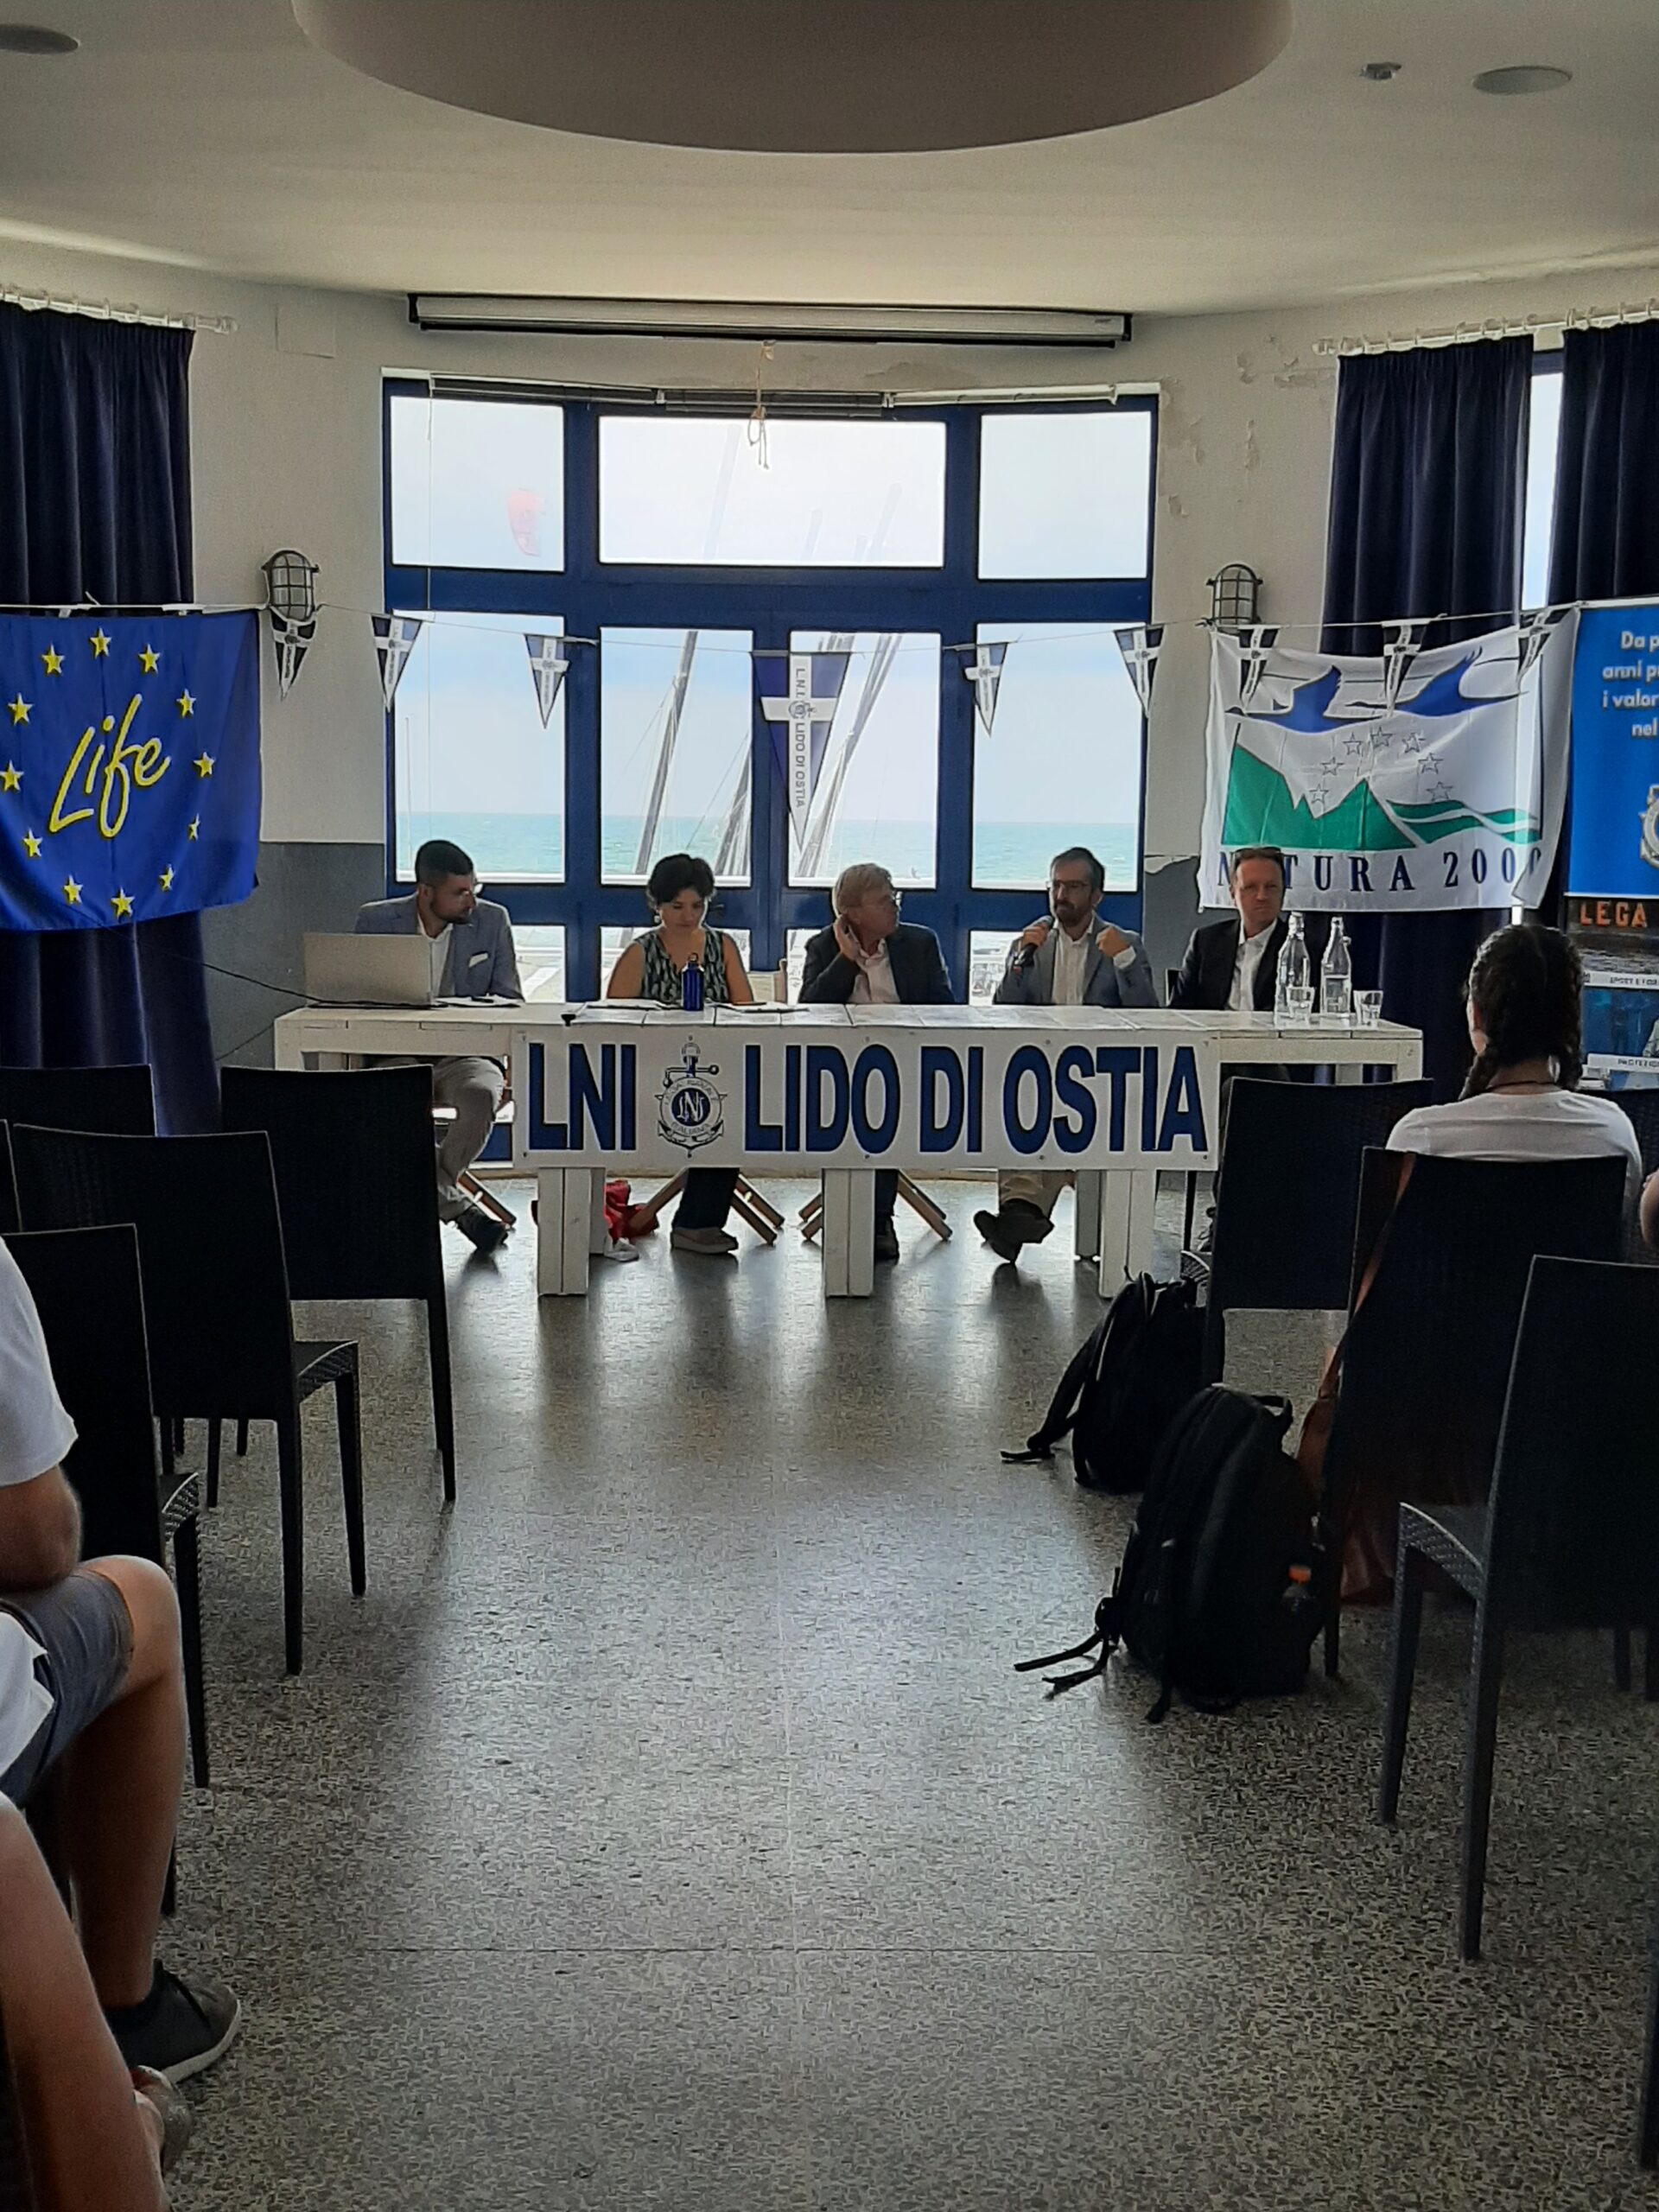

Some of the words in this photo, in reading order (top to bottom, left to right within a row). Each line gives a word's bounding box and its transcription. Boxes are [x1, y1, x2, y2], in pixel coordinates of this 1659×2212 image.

[1621, 631, 1645, 649] Da
[1603, 659, 1642, 679] anni
[1603, 690, 1608, 708] i
[795, 722, 805, 752] LIDO
[1631, 717, 1658, 736] nel
[49, 694, 171, 838] Life
[795, 755, 805, 767] DI
[795, 771, 806, 808] OSTIA
[1217, 849, 1415, 892] NTURA
[1580, 901, 1648, 928] LEGA
[529, 1043, 637, 1150] LNI
[745, 1044, 900, 1154] LIDO
[919, 1046, 984, 1153] DI
[1003, 1045, 1208, 1154] OSTIA
